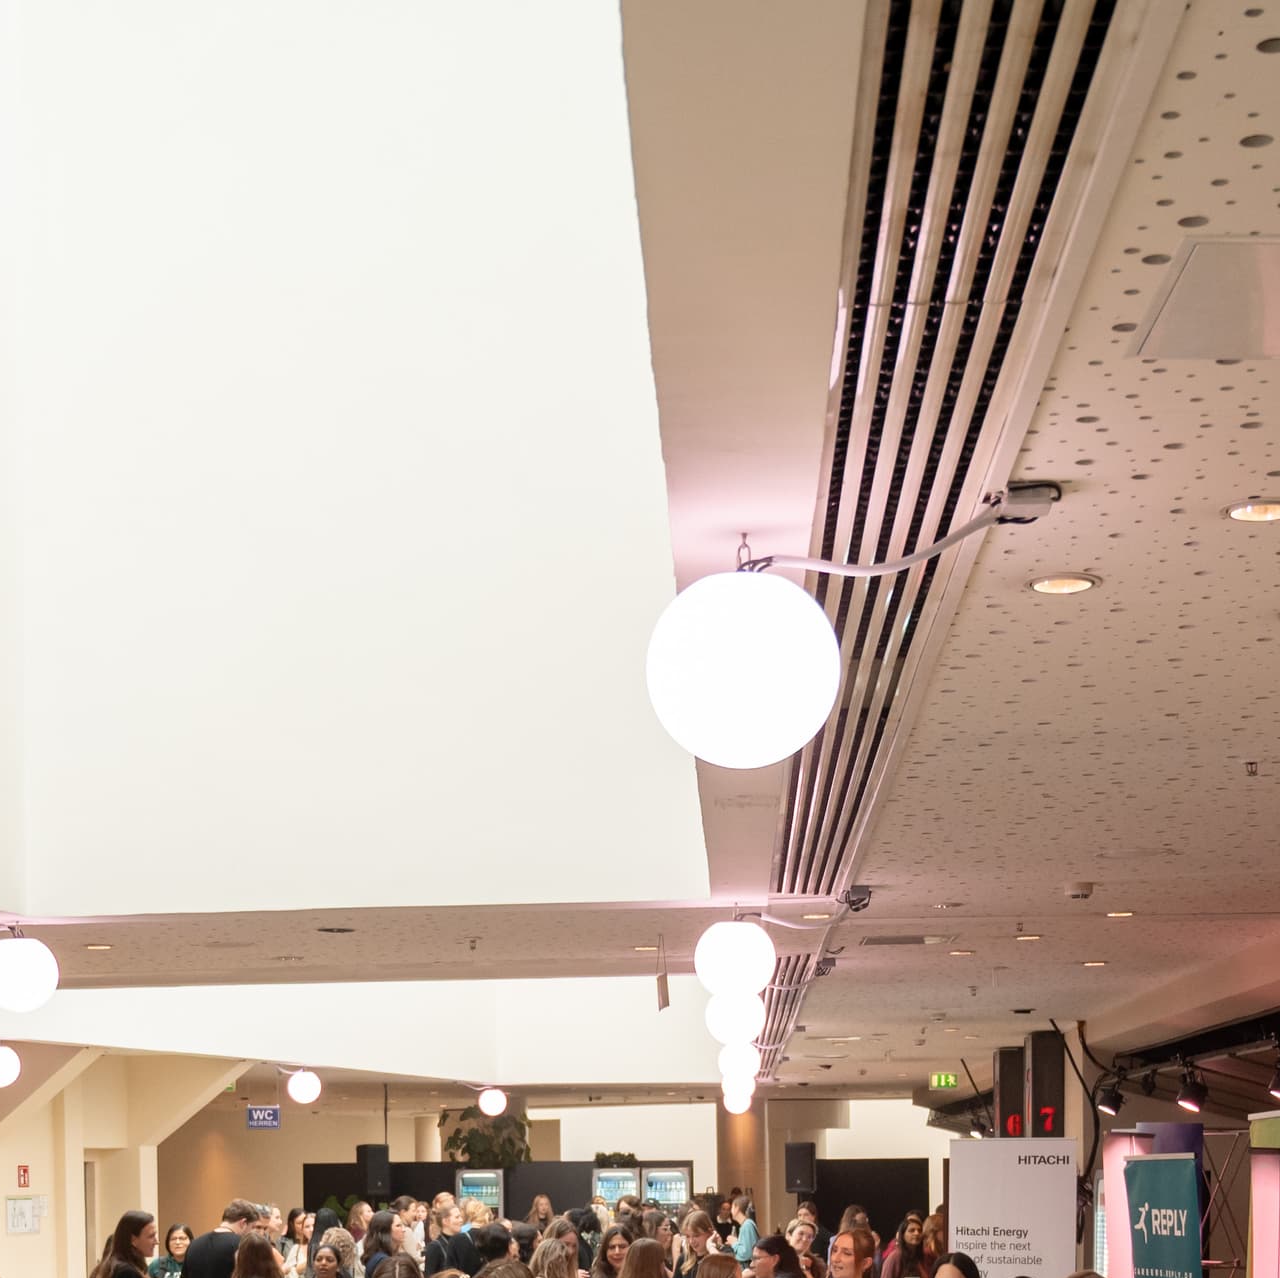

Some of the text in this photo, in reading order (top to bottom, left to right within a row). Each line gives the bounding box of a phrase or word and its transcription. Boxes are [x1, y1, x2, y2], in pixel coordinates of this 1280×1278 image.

[252, 1110, 274, 1120] WC
[1040, 1106, 1056, 1132] 7
[1007, 1113, 1022, 1136] 6
[1017, 1155, 1070, 1165] HITACHI
[1151, 1209, 1187, 1236] REPLY
[955, 1226, 1029, 1239] Hitachi Energy
[955, 1240, 1031, 1251] Inspire the next
[973, 1255, 1043, 1265] of sustainable
